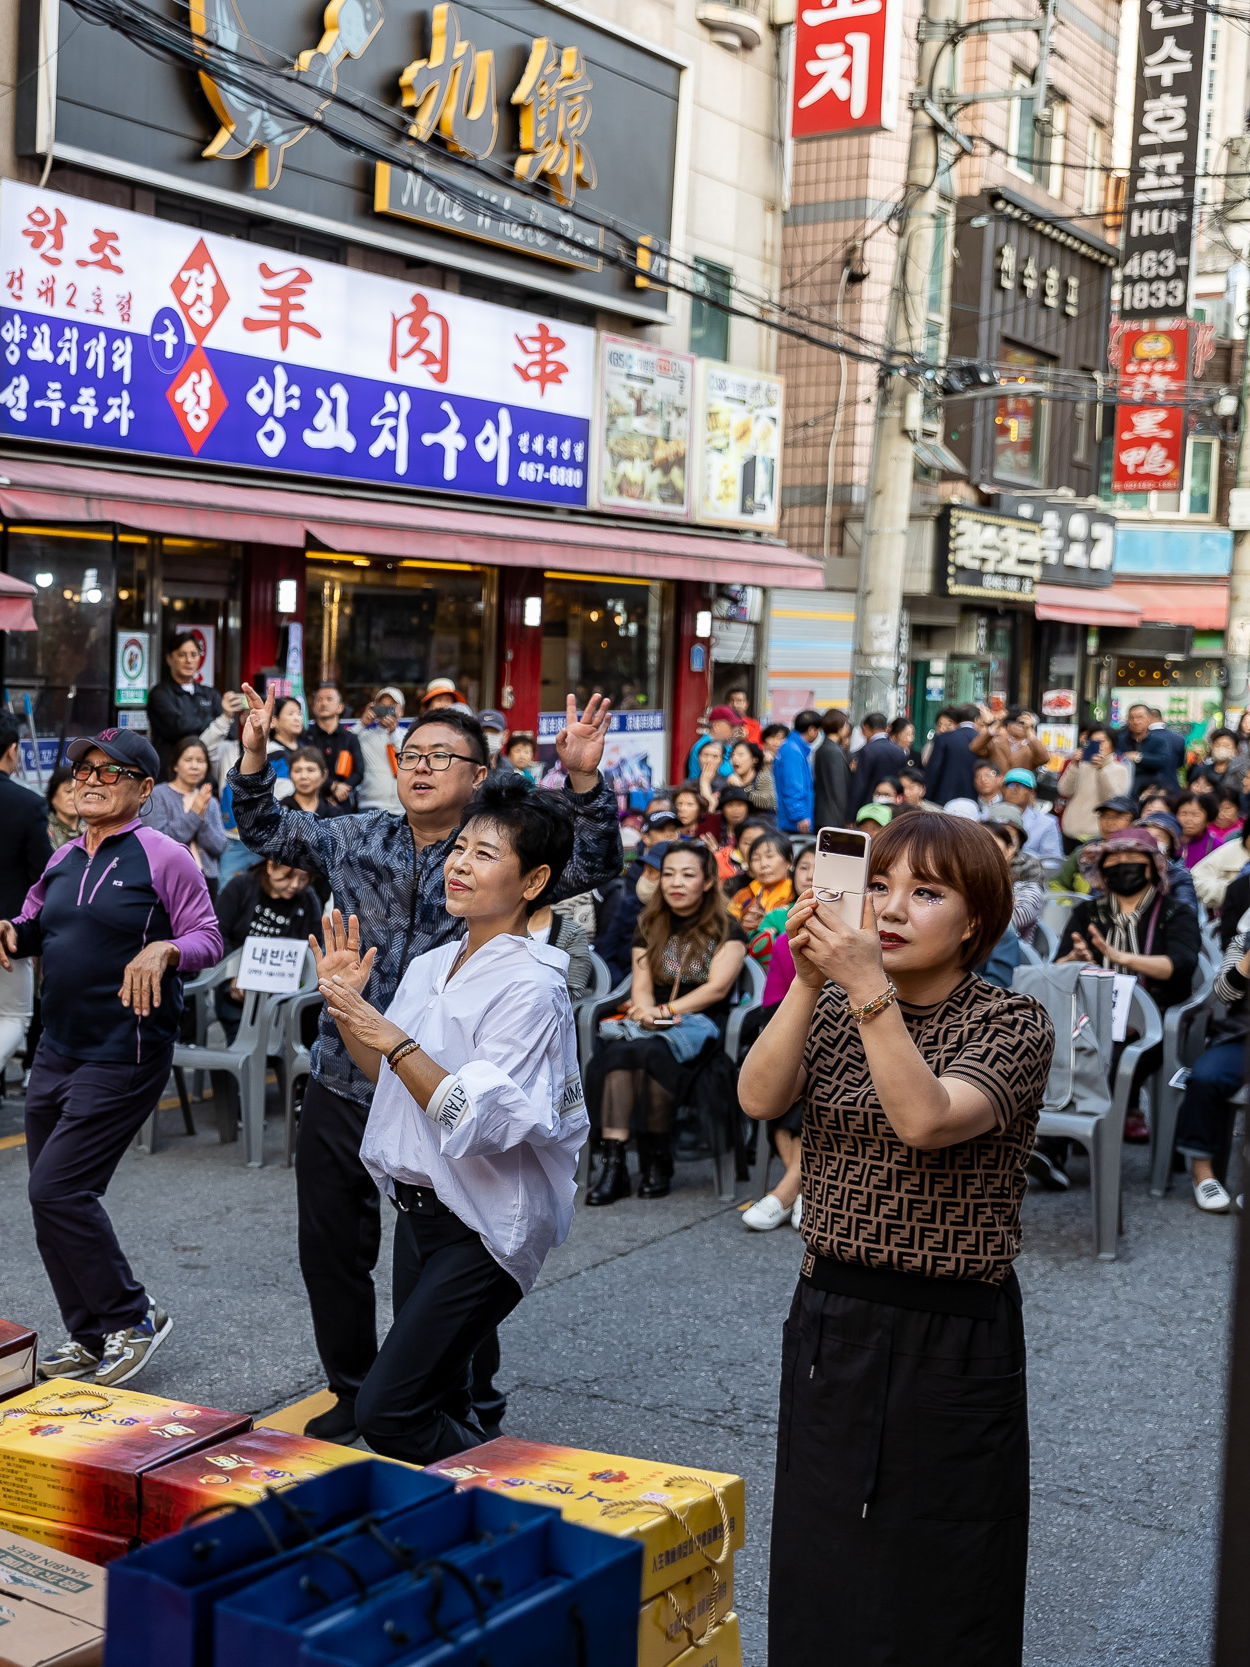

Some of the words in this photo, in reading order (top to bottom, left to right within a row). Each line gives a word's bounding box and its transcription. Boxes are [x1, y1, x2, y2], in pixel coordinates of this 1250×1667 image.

[22, 206, 124, 274] 원조
[1122, 278, 1186, 311] 1833
[0, 313, 133, 385] 양꼬치거리
[243, 262, 569, 398] 羊肉串
[246, 364, 513, 487] 양꼬치구이
[252, 947, 298, 967] 내빈석
[8, 1544, 37, 1563] BEER
[35, 1554, 91, 1580] HARBIN
